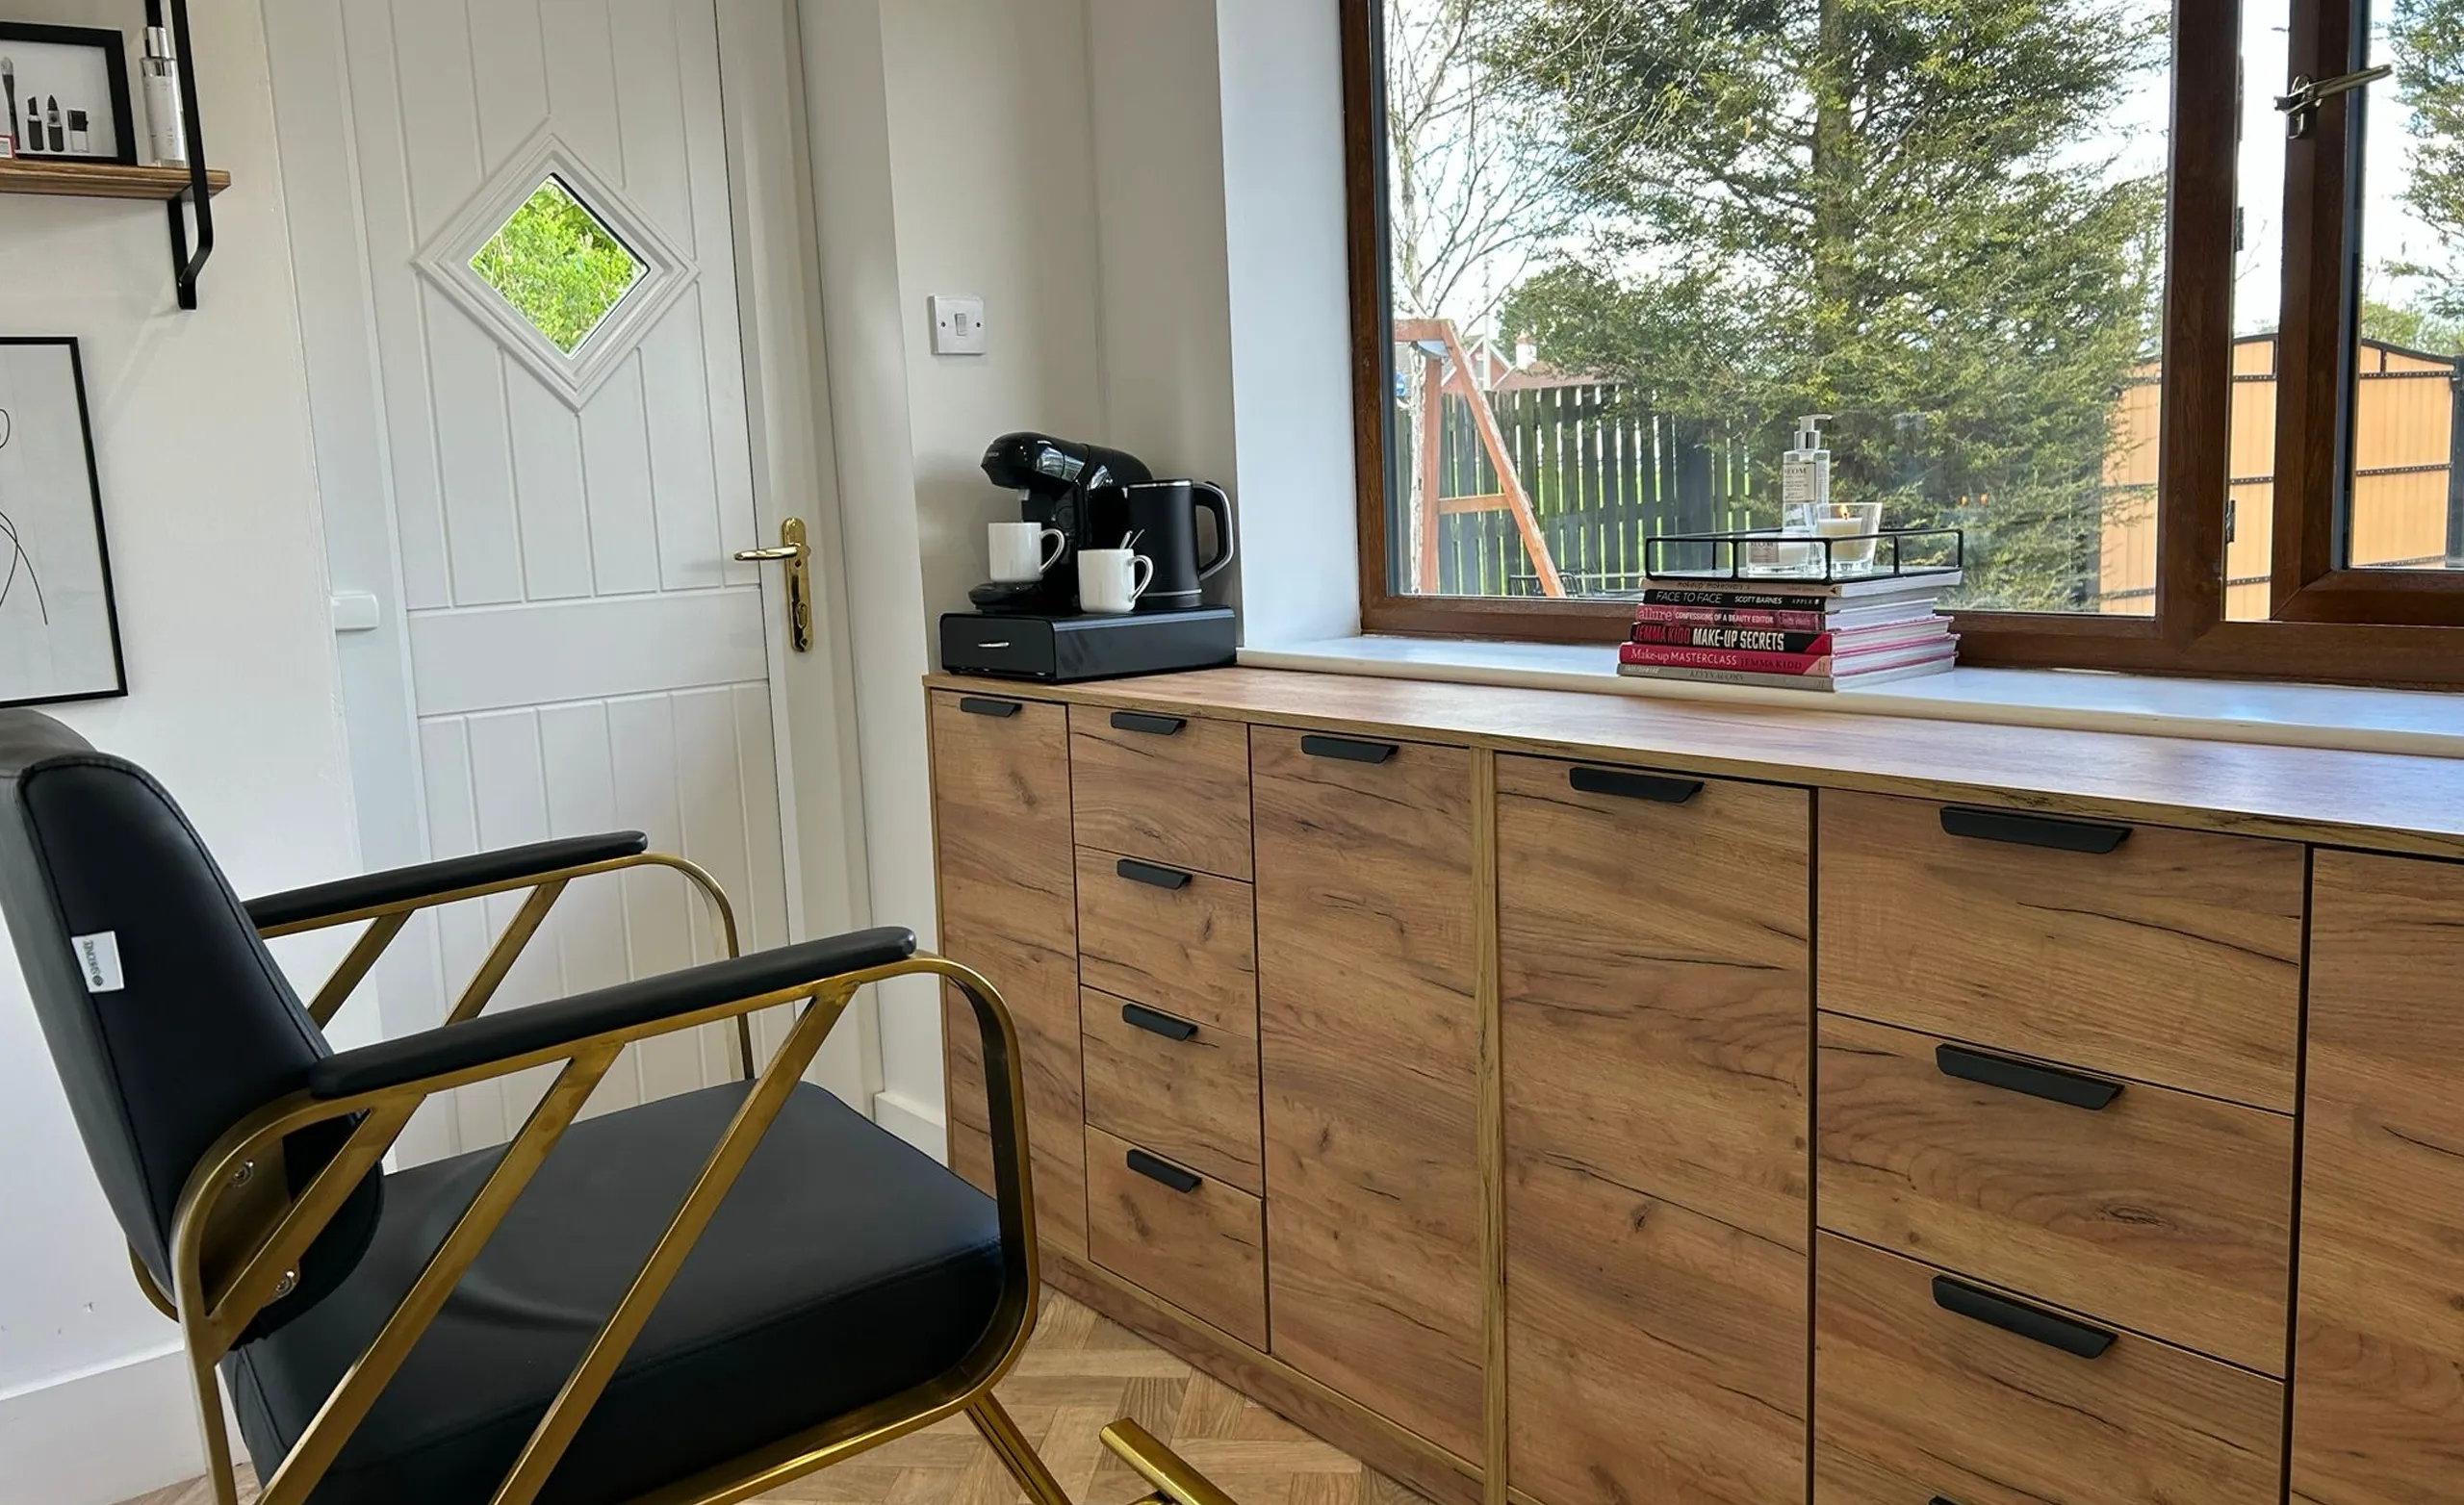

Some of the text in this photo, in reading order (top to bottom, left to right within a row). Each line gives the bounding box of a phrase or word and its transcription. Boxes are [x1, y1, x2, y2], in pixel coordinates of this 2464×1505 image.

[1656, 591, 1680, 602] FACE
[1683, 592, 1696, 602] TO
[1697, 593, 1723, 604] FACE
[1756, 597, 1783, 605] BARNES
[1638, 607, 1673, 622] allure
[1714, 613, 1722, 622] OF
[1729, 614, 1751, 623] BEAUTY
[1752, 615, 1774, 625] EDITOR
[1633, 624, 1784, 650] JEMMA KIDD MAKE-UP SECRETS
[1631, 648, 1803, 670] Make-up MASTERCLASS JEMMA KIDD
